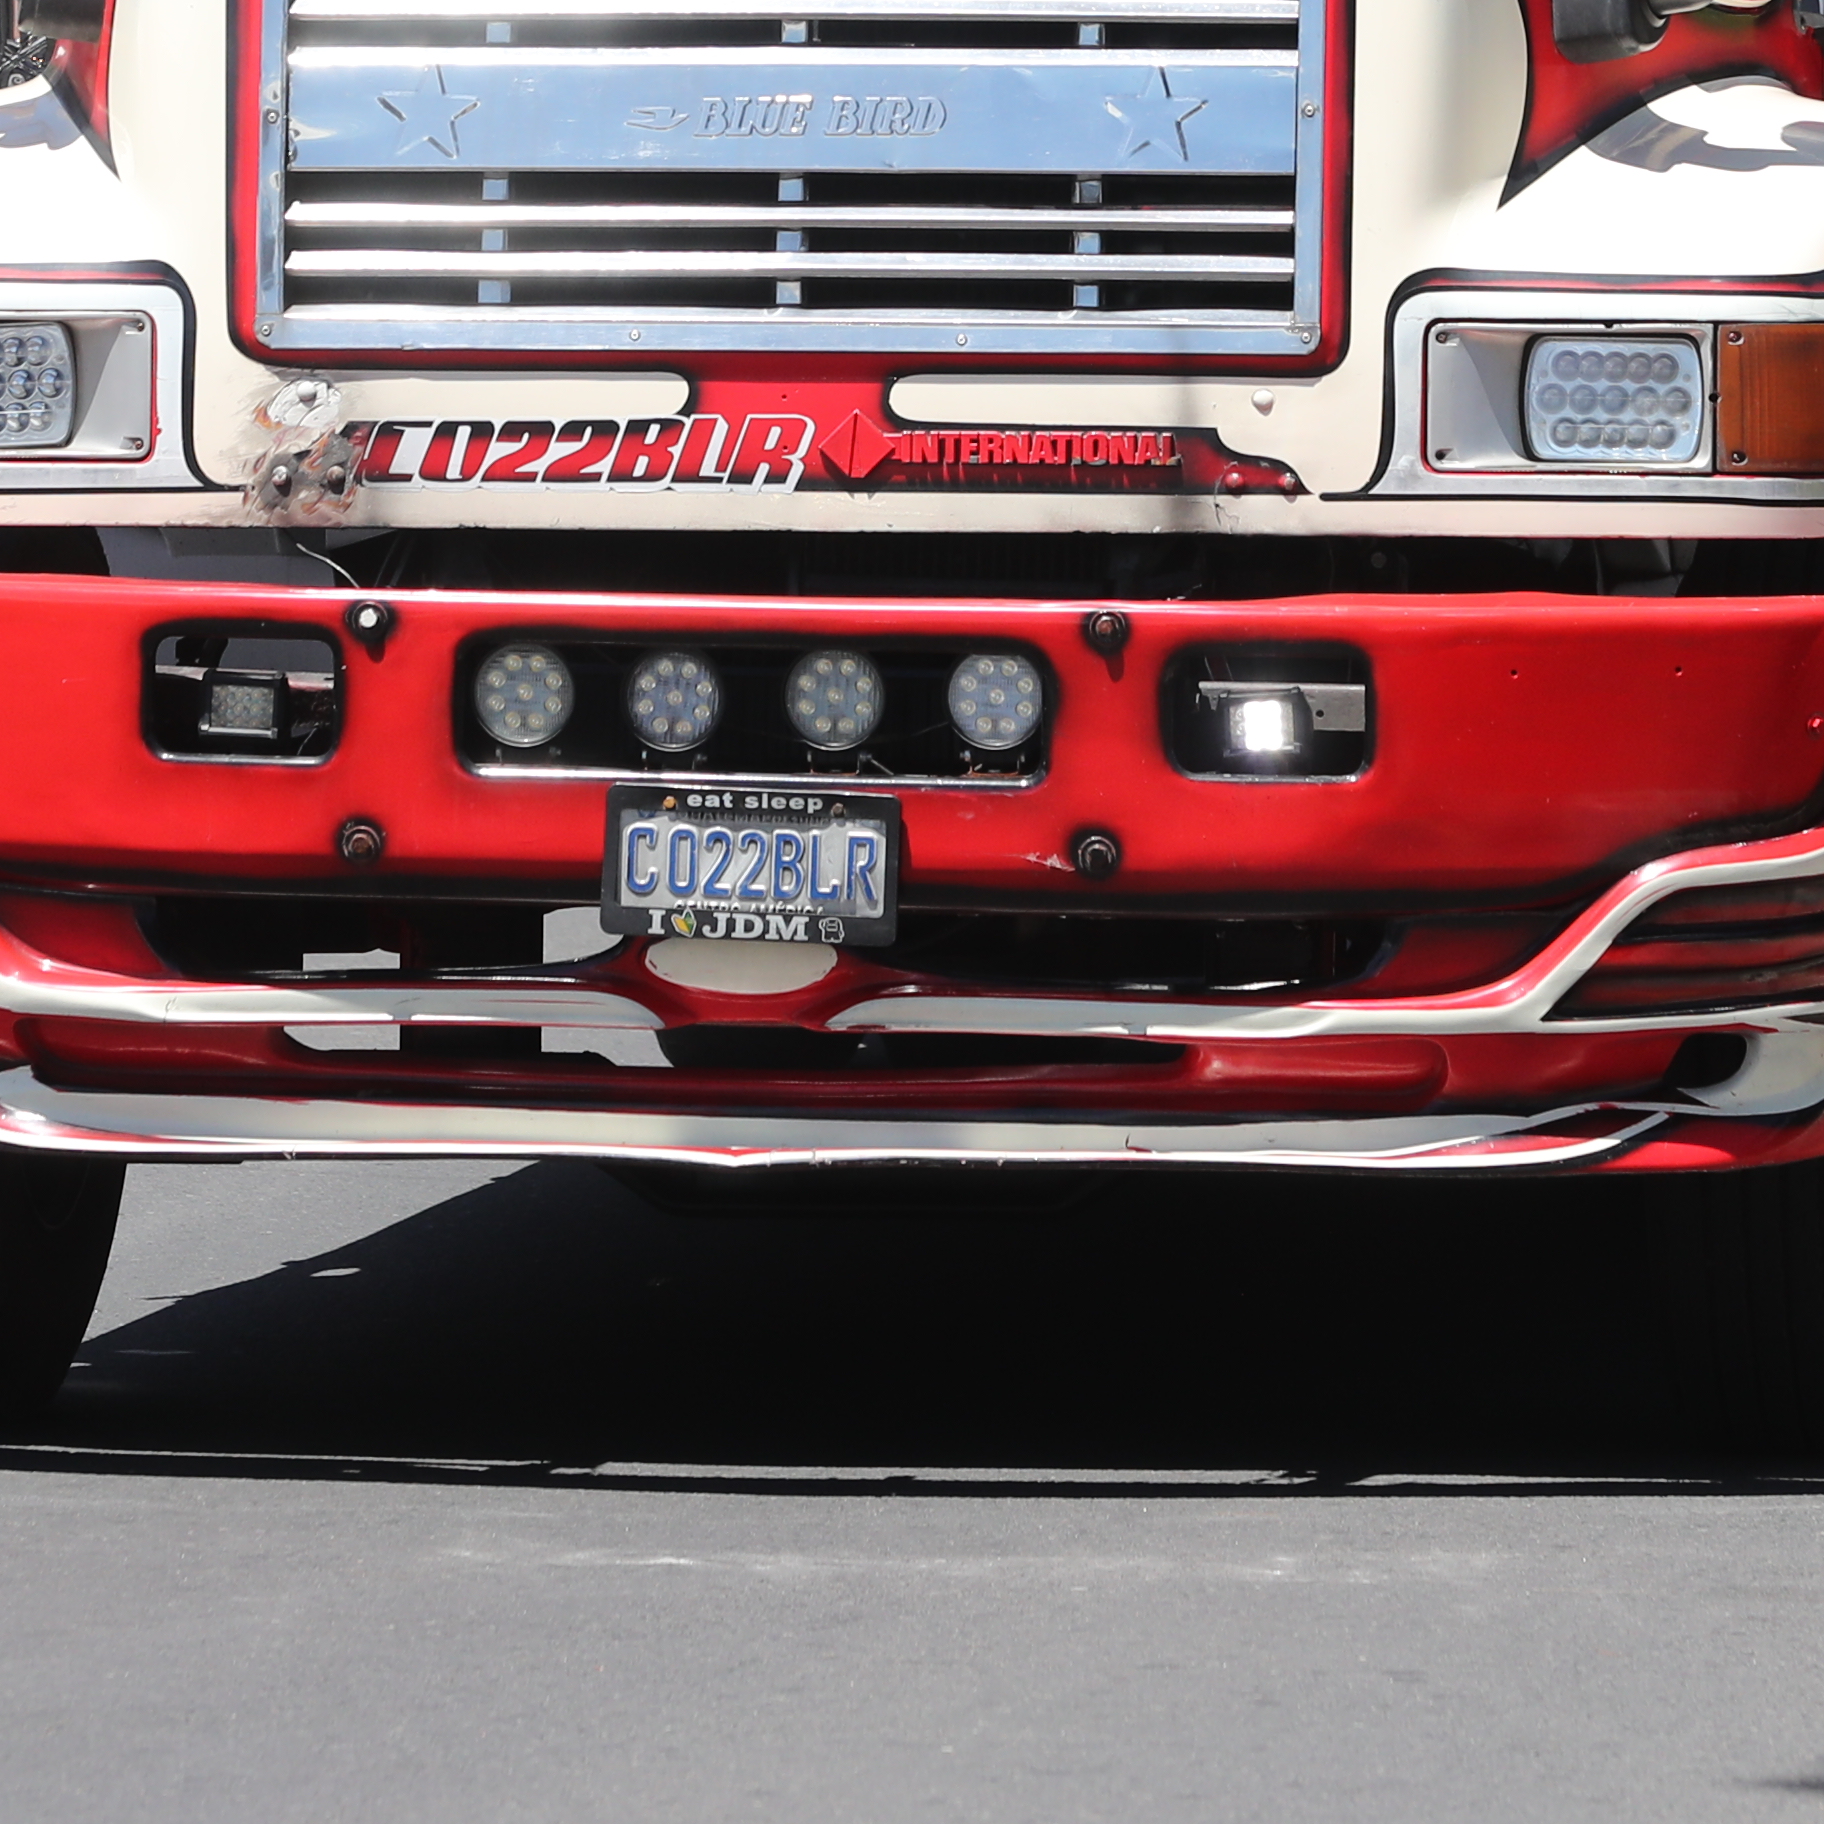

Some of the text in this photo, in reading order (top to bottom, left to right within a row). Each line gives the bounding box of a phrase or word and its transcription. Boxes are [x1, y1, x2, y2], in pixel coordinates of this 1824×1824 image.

[692, 94, 947, 137] BLUE BIRD
[899, 429, 1180, 466] INTERNATIONAL
[686, 792, 824, 814] eat sleep
[648, 909, 810, 942] I JDM
